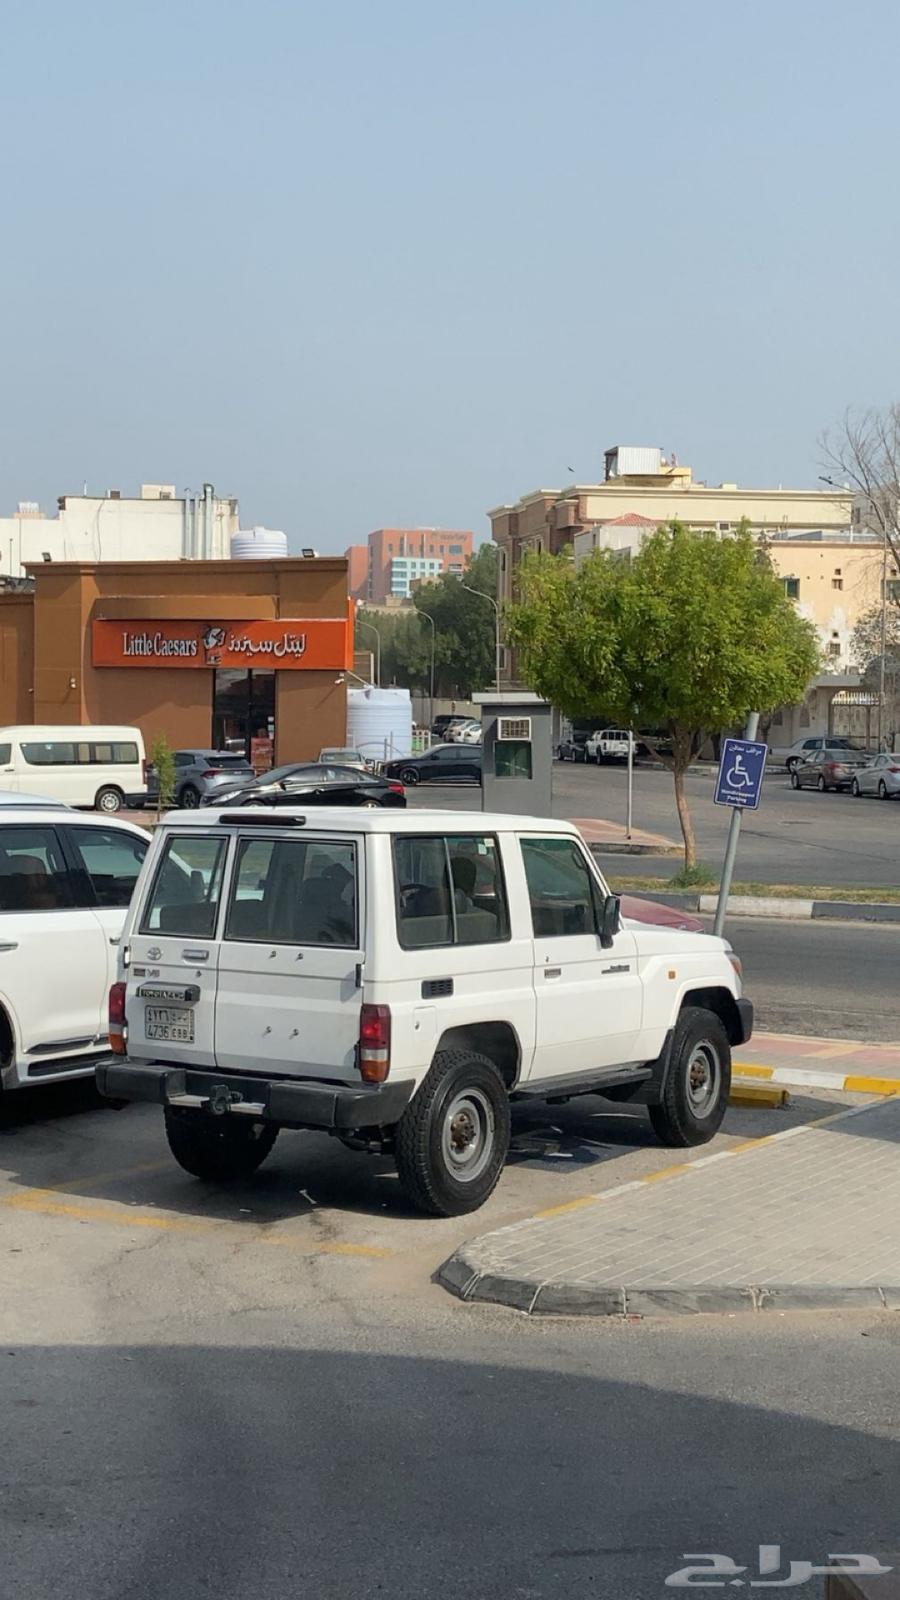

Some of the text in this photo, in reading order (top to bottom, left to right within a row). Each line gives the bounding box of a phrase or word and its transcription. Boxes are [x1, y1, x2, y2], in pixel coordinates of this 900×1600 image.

[123, 632, 197, 656] Little Caesars
[228, 633, 306, 657] ليتل سيزرز
[148, 1024, 169, 1038] 4736
